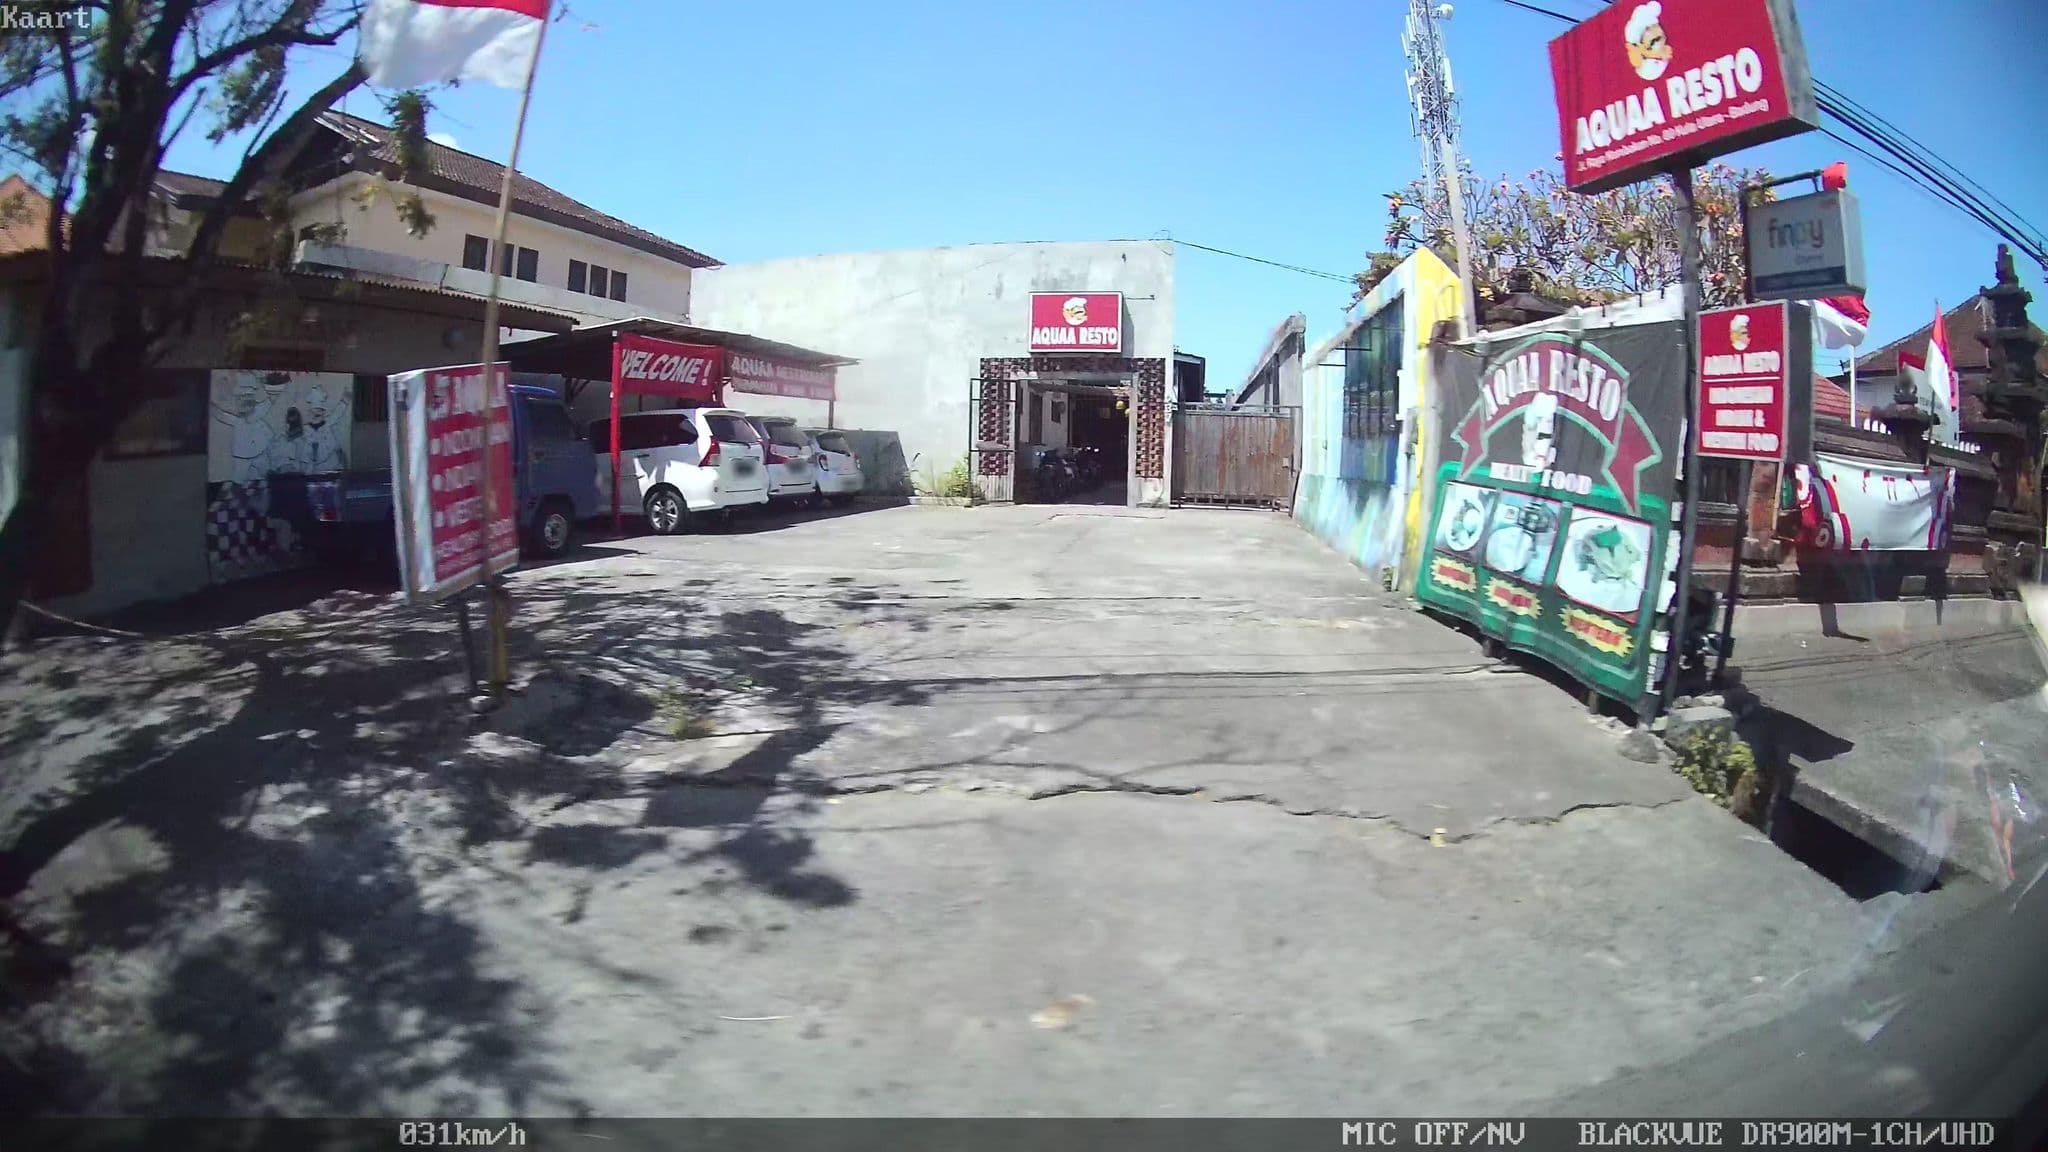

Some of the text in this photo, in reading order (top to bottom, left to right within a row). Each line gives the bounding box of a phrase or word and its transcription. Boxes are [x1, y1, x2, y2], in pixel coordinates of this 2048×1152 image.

[1576, 47, 1763, 155] AQUAA RESTO
[1031, 326, 1118, 345] AQUAA RESTO
[621, 350, 701, 384] WELCOME
[1548, 349, 1621, 421] RESTO
[1540, 468, 1592, 495] FOOD
